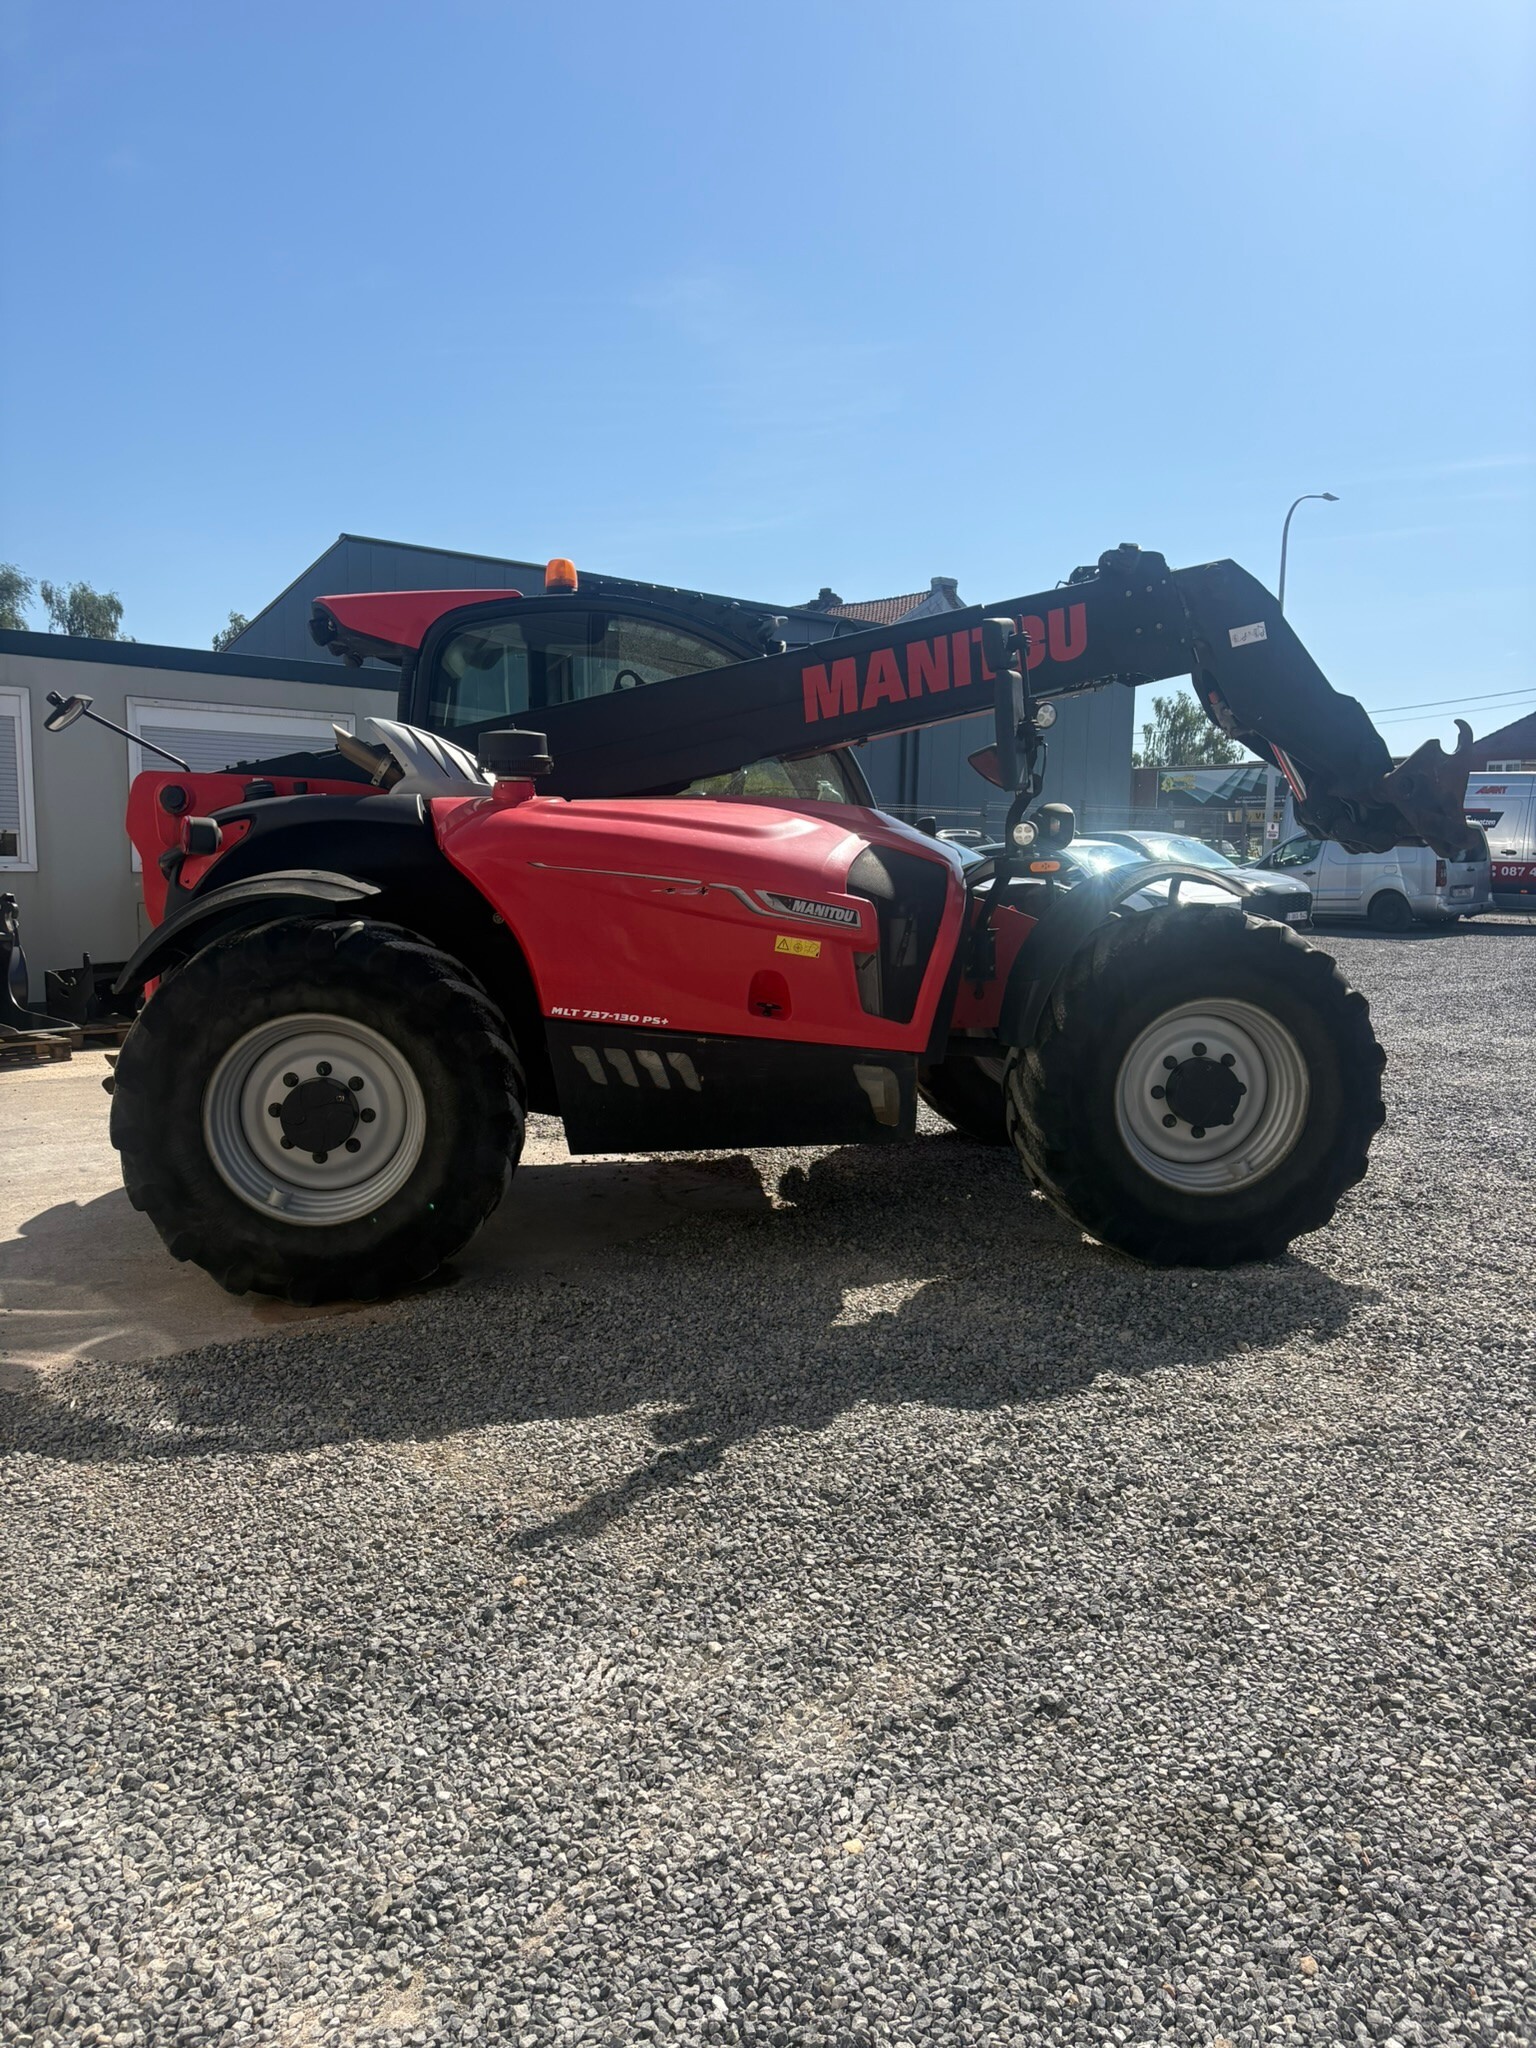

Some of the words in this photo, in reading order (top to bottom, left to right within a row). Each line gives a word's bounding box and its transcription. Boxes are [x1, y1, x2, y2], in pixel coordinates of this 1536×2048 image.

[1501, 866, 1525, 876] 087
[792, 900, 855, 922] MANITOU
[551, 1006, 580, 1016] MLT
[583, 1009, 639, 1022] 737-130
[642, 1015, 669, 1025] PS+
